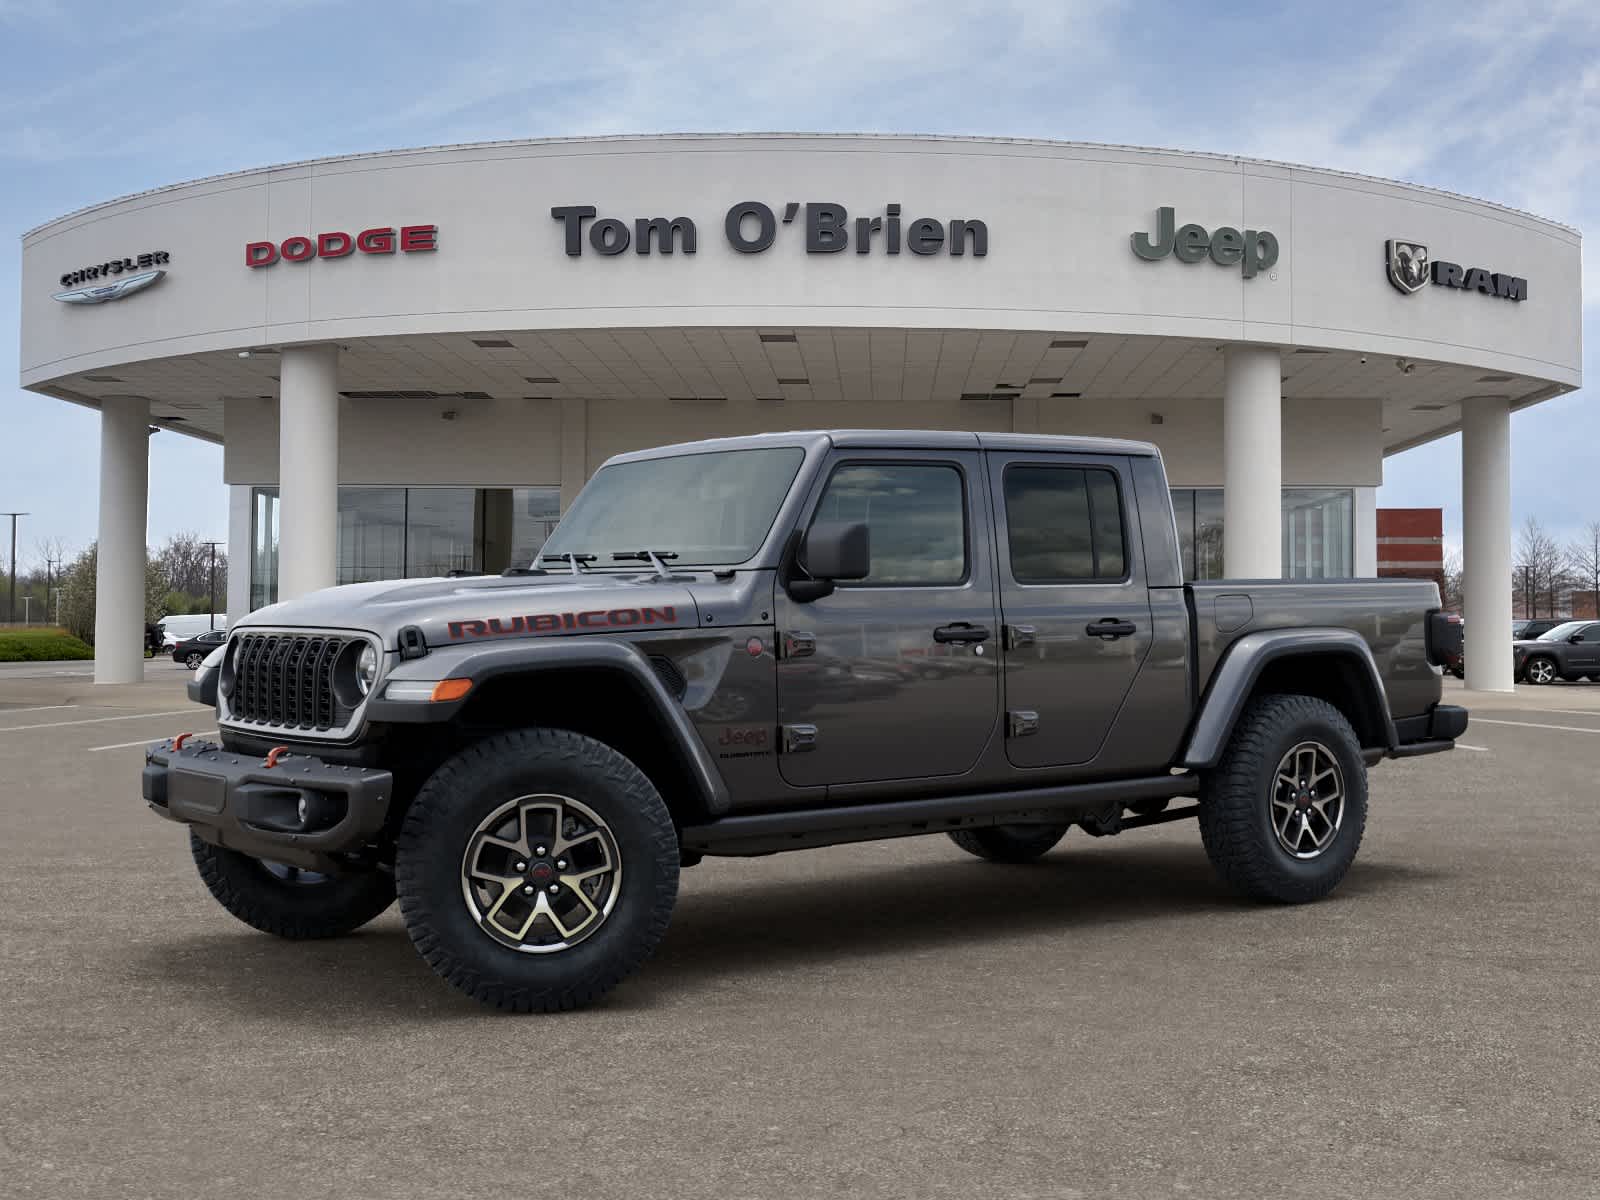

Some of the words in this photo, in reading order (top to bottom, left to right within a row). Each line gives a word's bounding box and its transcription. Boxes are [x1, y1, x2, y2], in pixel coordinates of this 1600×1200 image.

[245, 224, 439, 269] DODGE
[551, 205, 697, 257] Tom
[1130, 206, 1280, 279] Jeep
[60, 250, 171, 287] CHRYSLER
[1431, 260, 1528, 302] RAM
[448, 605, 677, 640] RUBICON
[719, 726, 768, 748] Jeep
